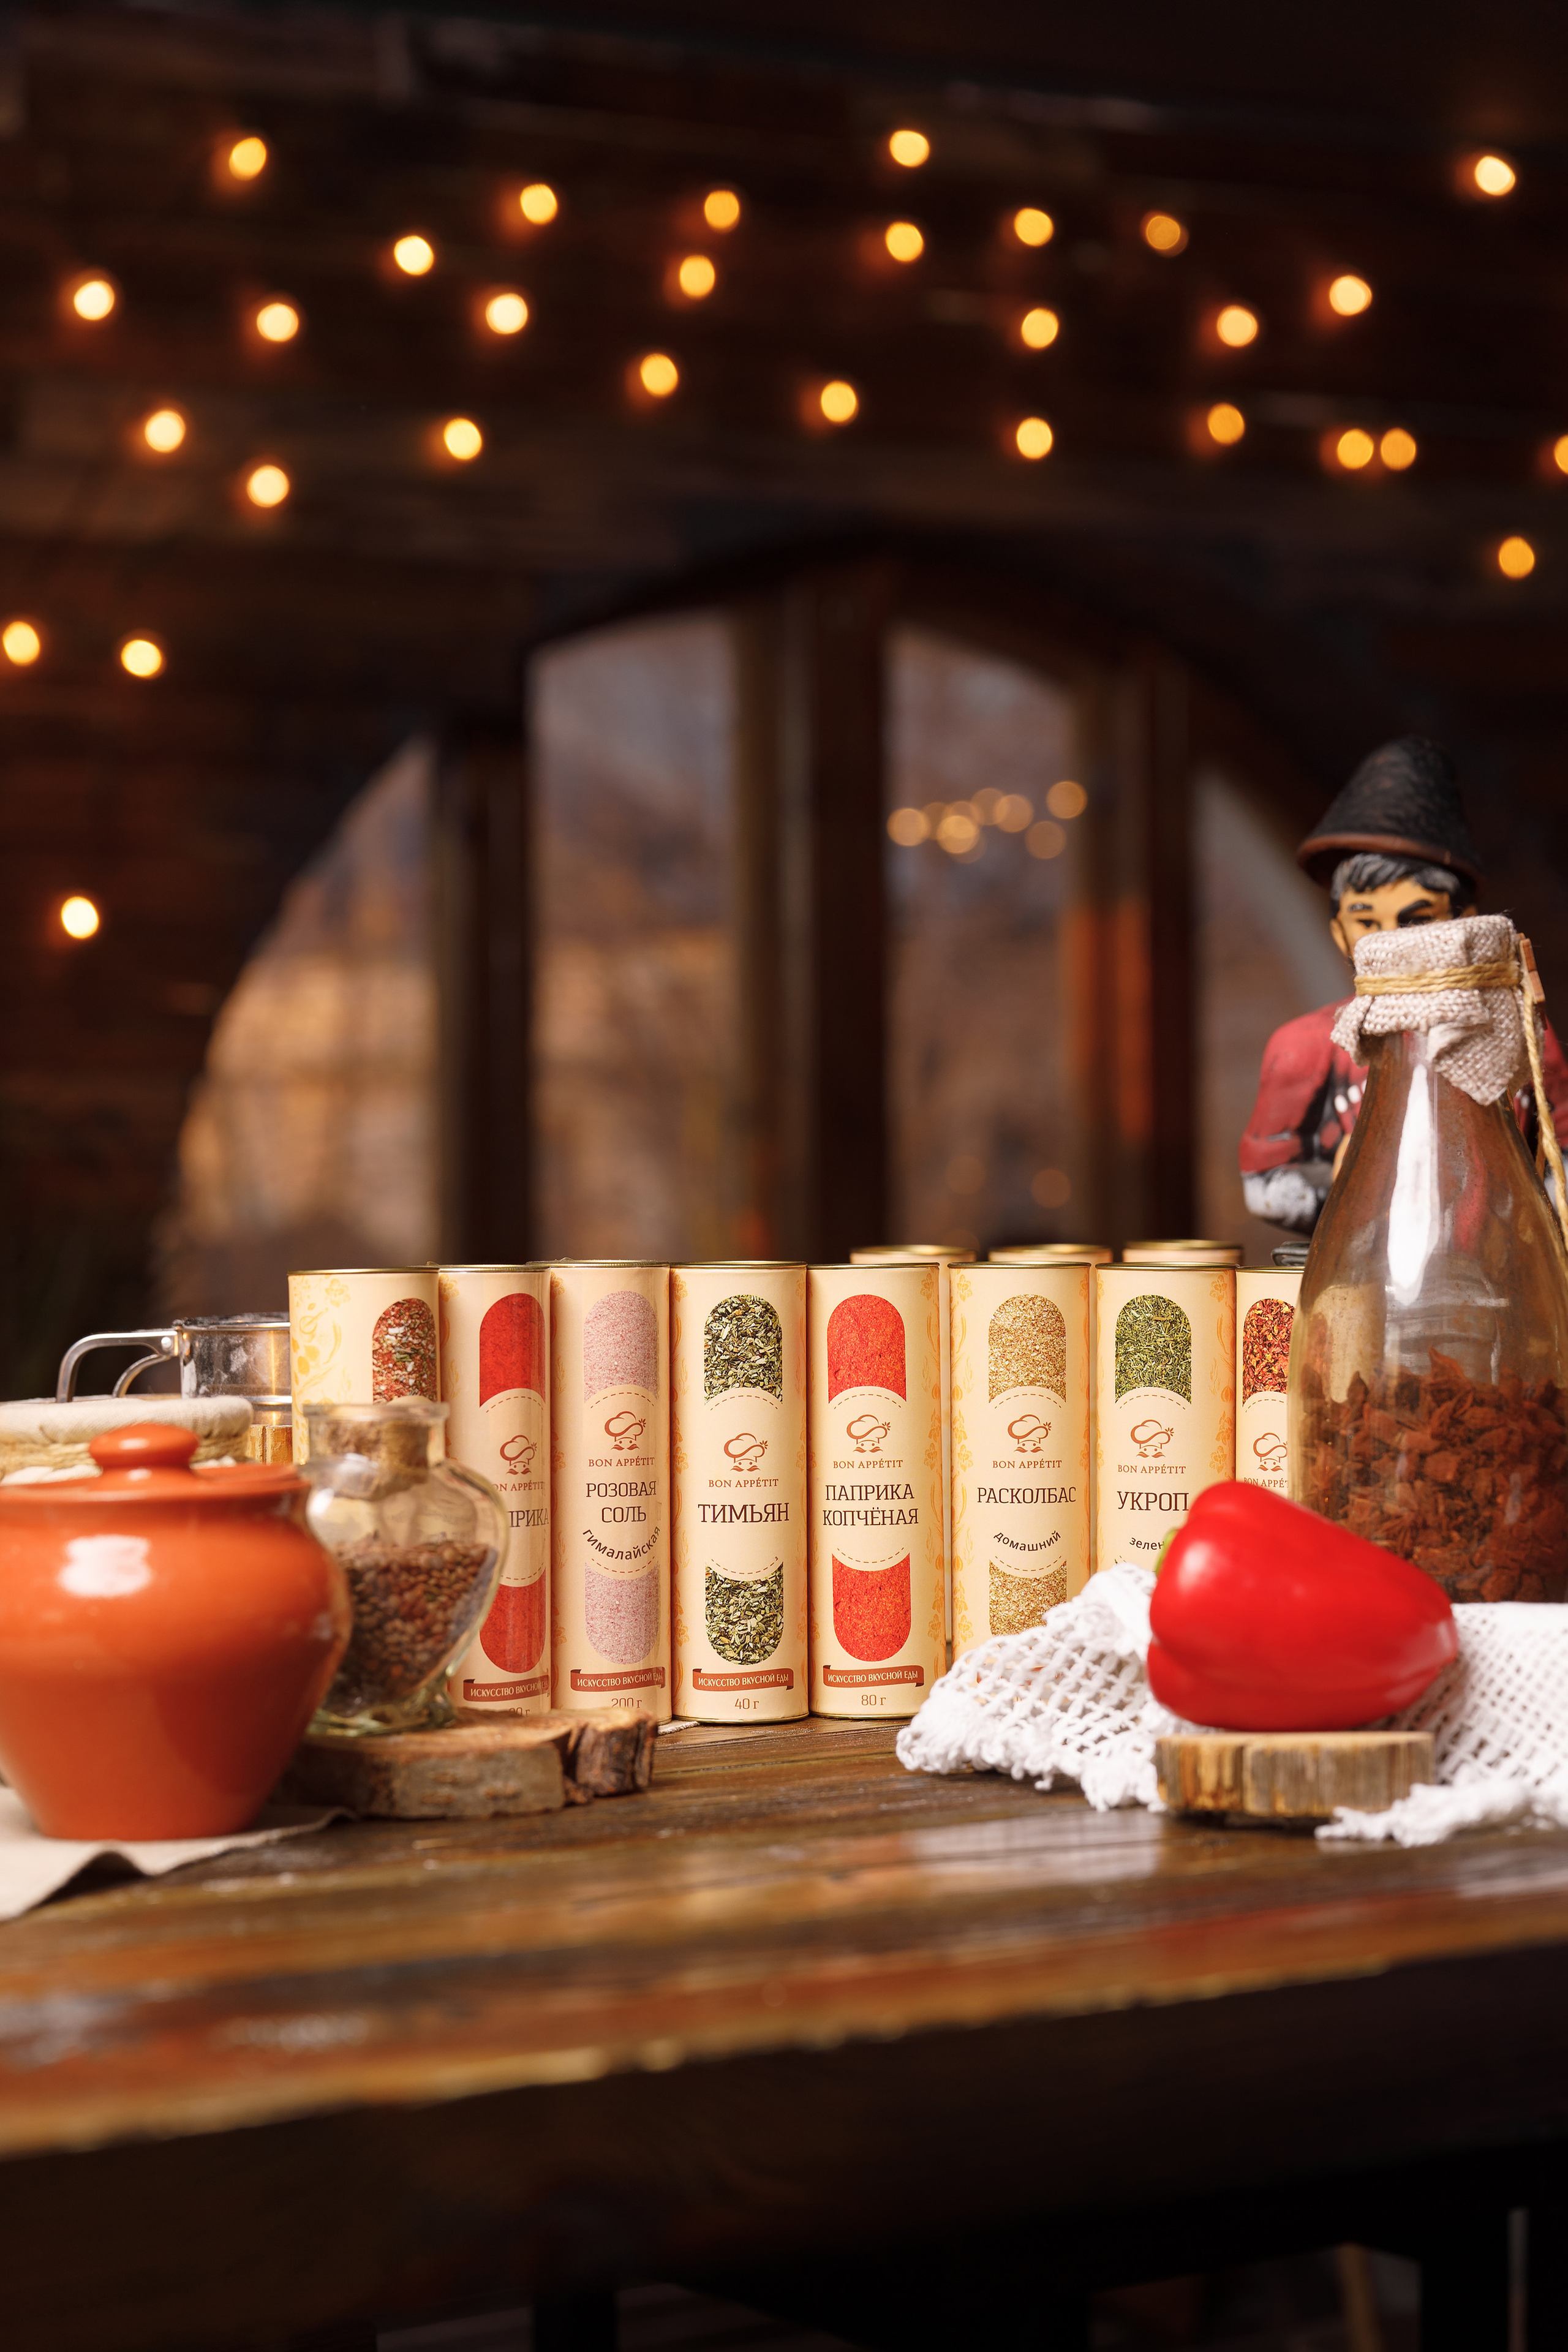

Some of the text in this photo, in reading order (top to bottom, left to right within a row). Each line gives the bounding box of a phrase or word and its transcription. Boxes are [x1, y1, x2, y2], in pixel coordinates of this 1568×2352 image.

[616, 1456, 655, 1466] APPÉTIT
[858, 1458, 903, 1469] APPÉTIT
[992, 1458, 1062, 1469] BON APPÉTIT
[1118, 1464, 1186, 1474] BON APPÉTIT
[510, 1480, 544, 1491] APPÉTIT
[586, 1480, 657, 1498] РОЗОВАЯ
[735, 1477, 779, 1488] APPÉTIT
[1261, 1478, 1289, 1488] APPÉT
[825, 1483, 915, 1501] ПАПРИКА
[977, 1487, 1076, 1504] РАСКОЛБАС
[1117, 1491, 1189, 1511] УКРОП
[507, 1508, 549, 1528] ПРИКА
[601, 1506, 646, 1523] СОЛЬ
[698, 1502, 790, 1523] ТИМЬЯН
[823, 1507, 919, 1526] КОПЧЁНАЯ
[582, 1526, 660, 1560] гималайская
[993, 1530, 1061, 1551] домашний
[1129, 1537, 1164, 1550] зелен
[577, 1677, 621, 1687] ИСКУССТВО
[622, 1672, 652, 1685] ВКУСНОЙ
[698, 1673, 789, 1687] ИСКУССТВО ВКУСНОЙ ЕДЫ
[827, 1670, 918, 1683] ИСКУССТВО ВКУСНОЙ ЕДЫ
[470, 1686, 514, 1697] ИСКУССТВО
[516, 1680, 541, 1694] ВКУСНОЙ
[611, 1697, 643, 1709] 200 г
[734, 1698, 760, 1709] 40 г
[861, 1694, 886, 1706] 80 г
